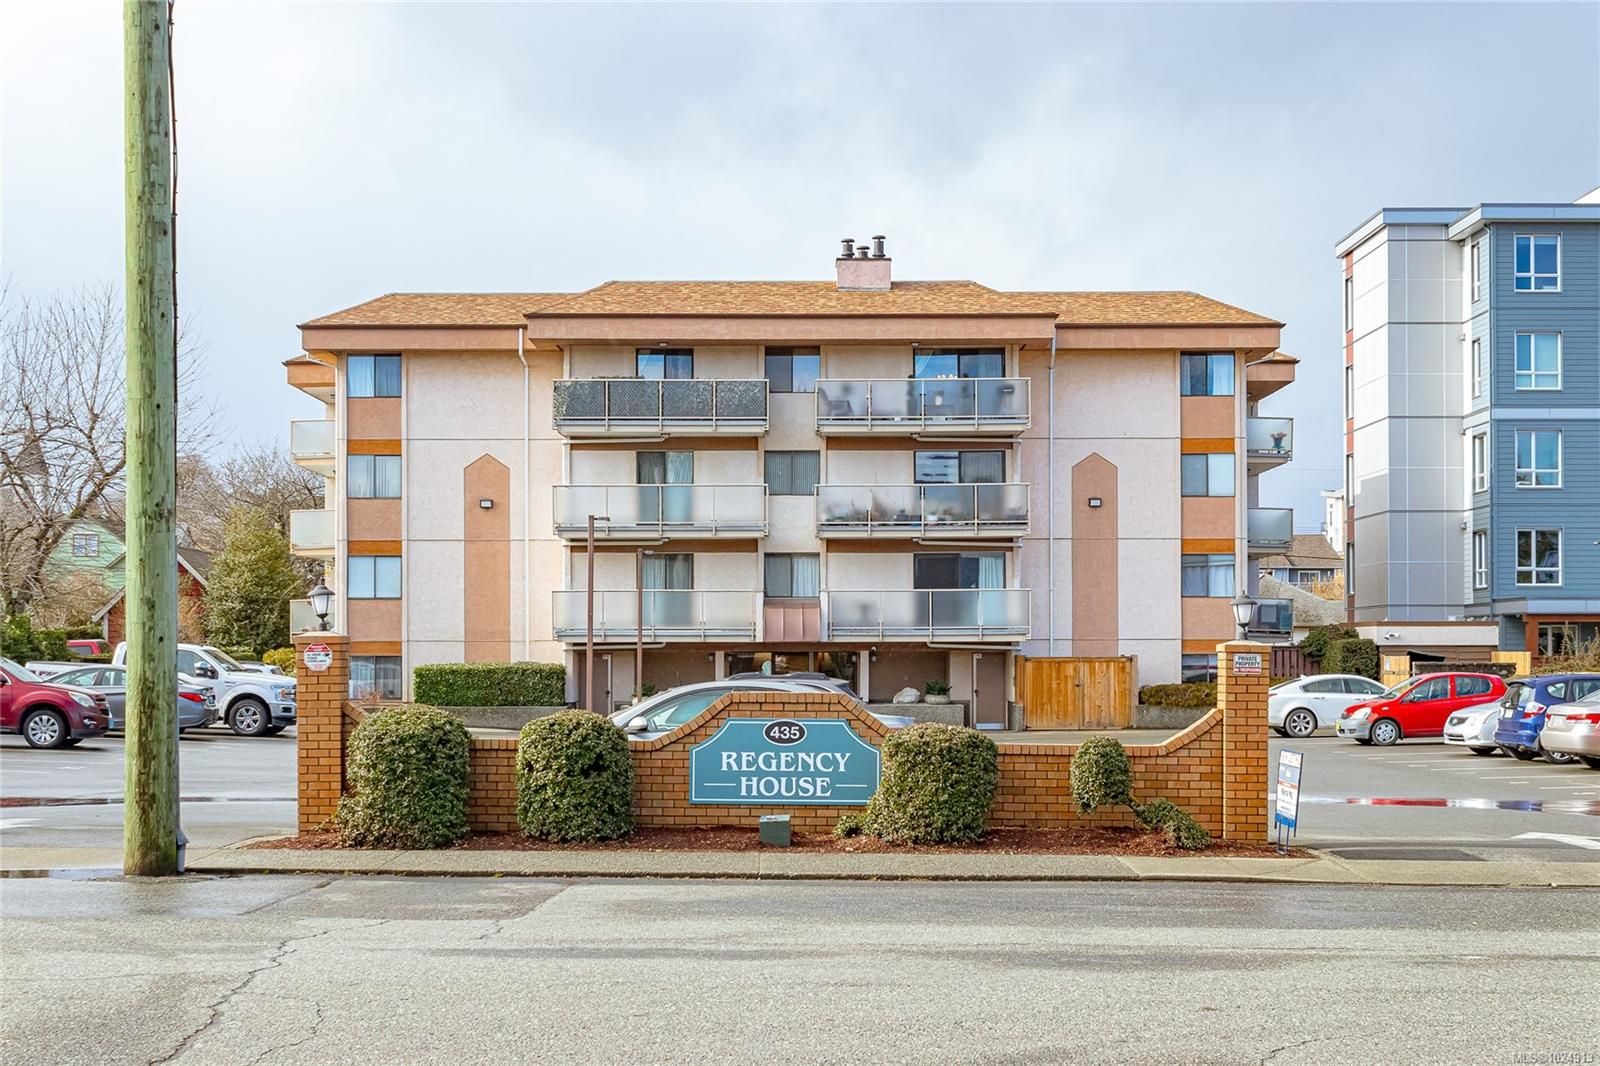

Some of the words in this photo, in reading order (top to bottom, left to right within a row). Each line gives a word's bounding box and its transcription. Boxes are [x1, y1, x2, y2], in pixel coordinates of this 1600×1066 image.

[769, 726, 800, 739] 435
[720, 751, 851, 772] REGENCY
[740, 776, 832, 797] HOUSE
